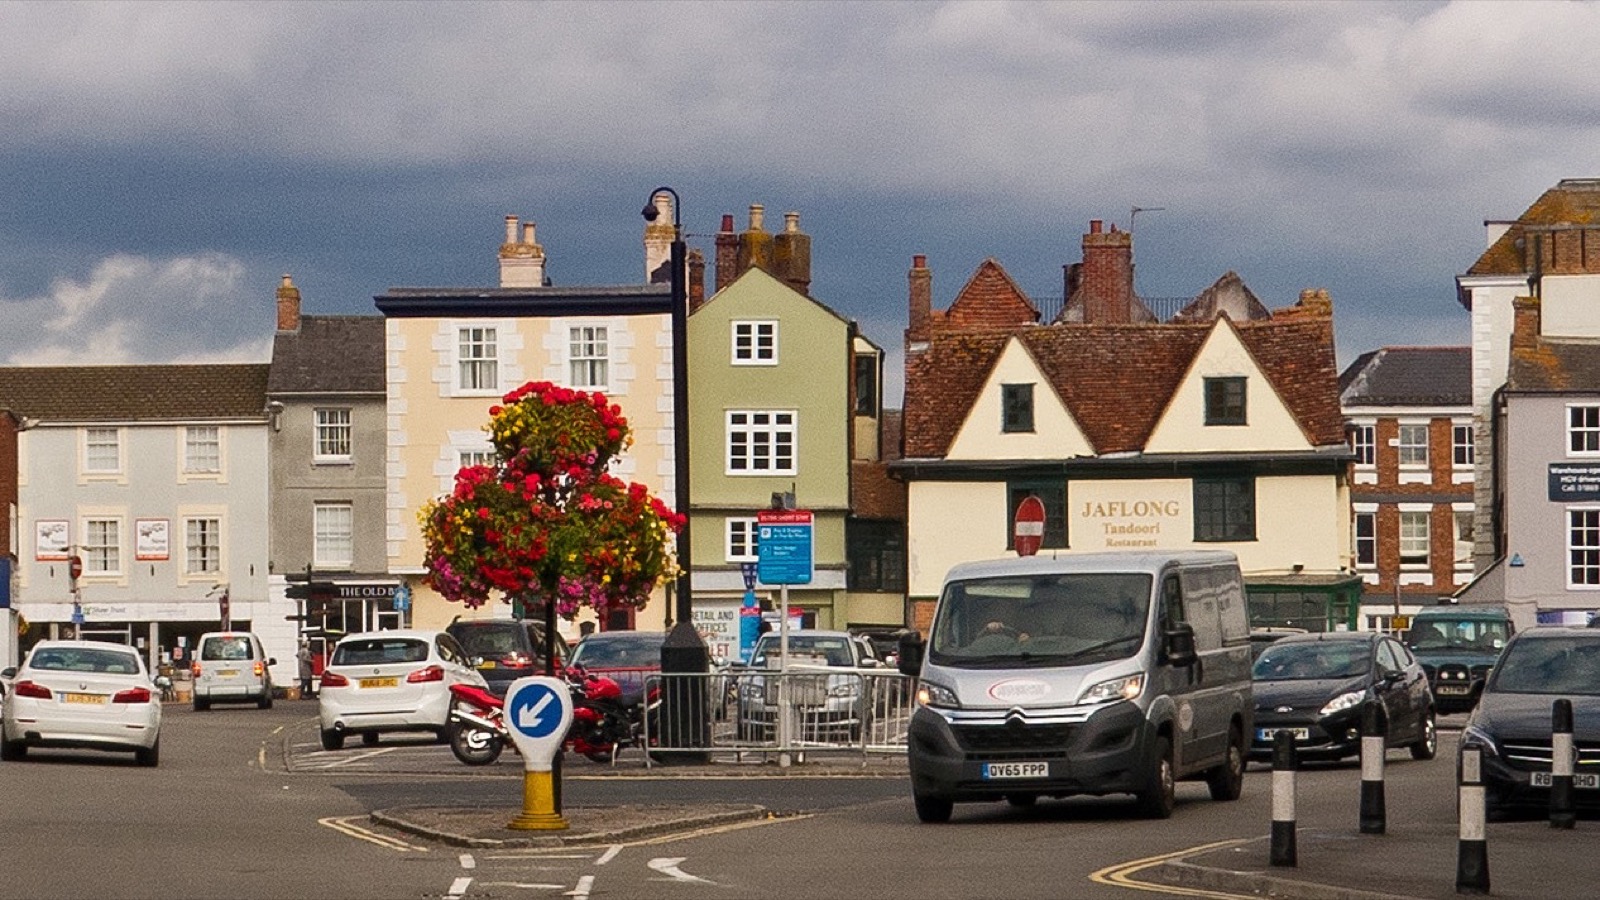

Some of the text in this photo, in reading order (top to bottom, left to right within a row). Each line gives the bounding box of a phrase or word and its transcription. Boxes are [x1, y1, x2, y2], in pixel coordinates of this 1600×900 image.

[1081, 500, 1179, 517] JAFLONG
[1103, 522, 1160, 534] Tandoori
[1106, 538, 1158, 547] Restaurant
[340, 587, 361, 596] THE
[362, 587, 386, 596] OLD
[718, 611, 734, 621] AND
[1022, 764, 1046, 776] FPP
